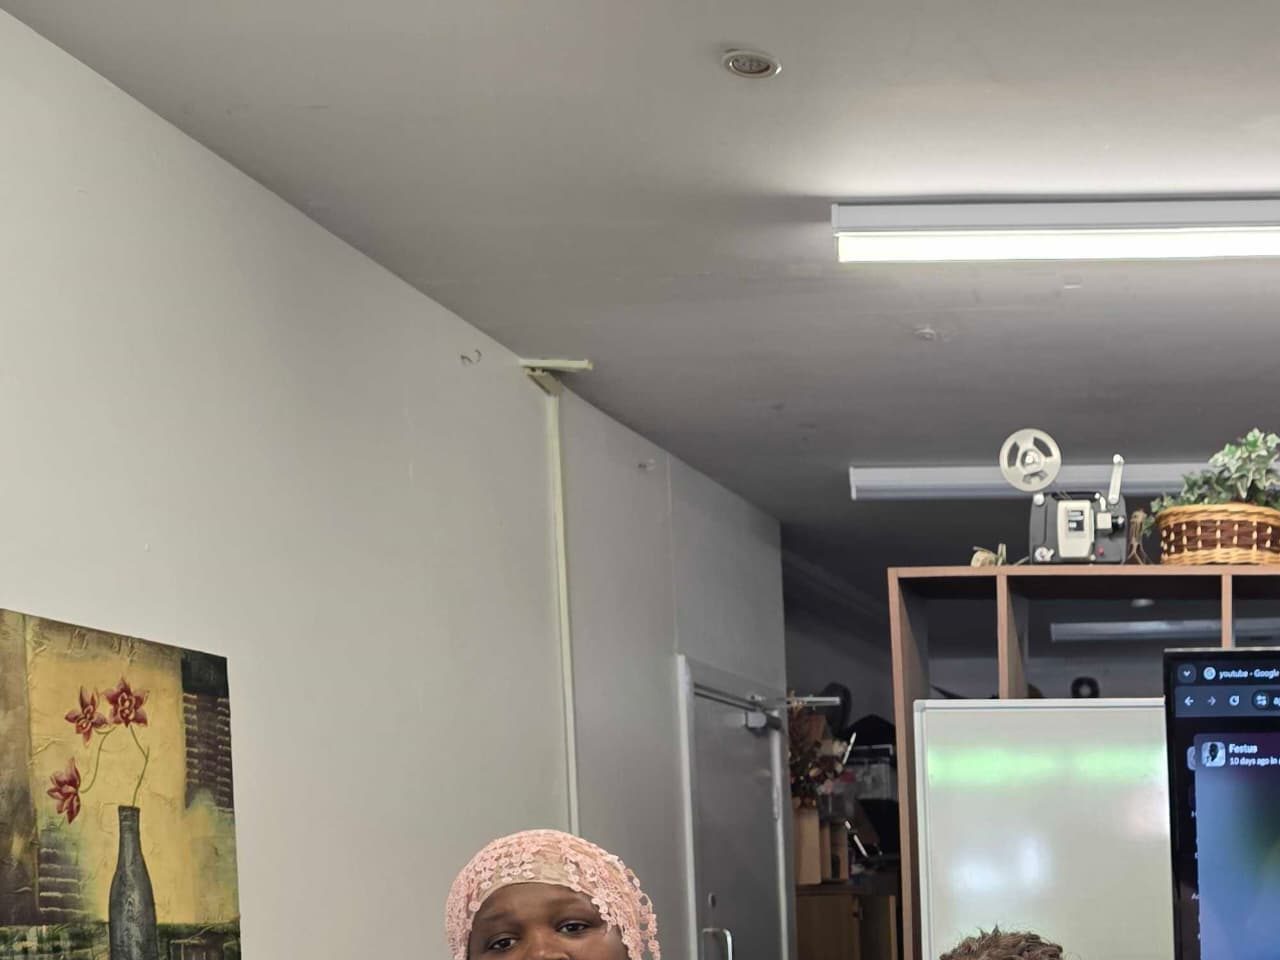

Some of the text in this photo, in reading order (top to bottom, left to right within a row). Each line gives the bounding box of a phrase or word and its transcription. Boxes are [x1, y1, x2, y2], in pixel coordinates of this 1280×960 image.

[1218, 669, 1248, 679] youtube
[1240, 757, 1256, 767] days
[1257, 758, 1269, 767] ago
